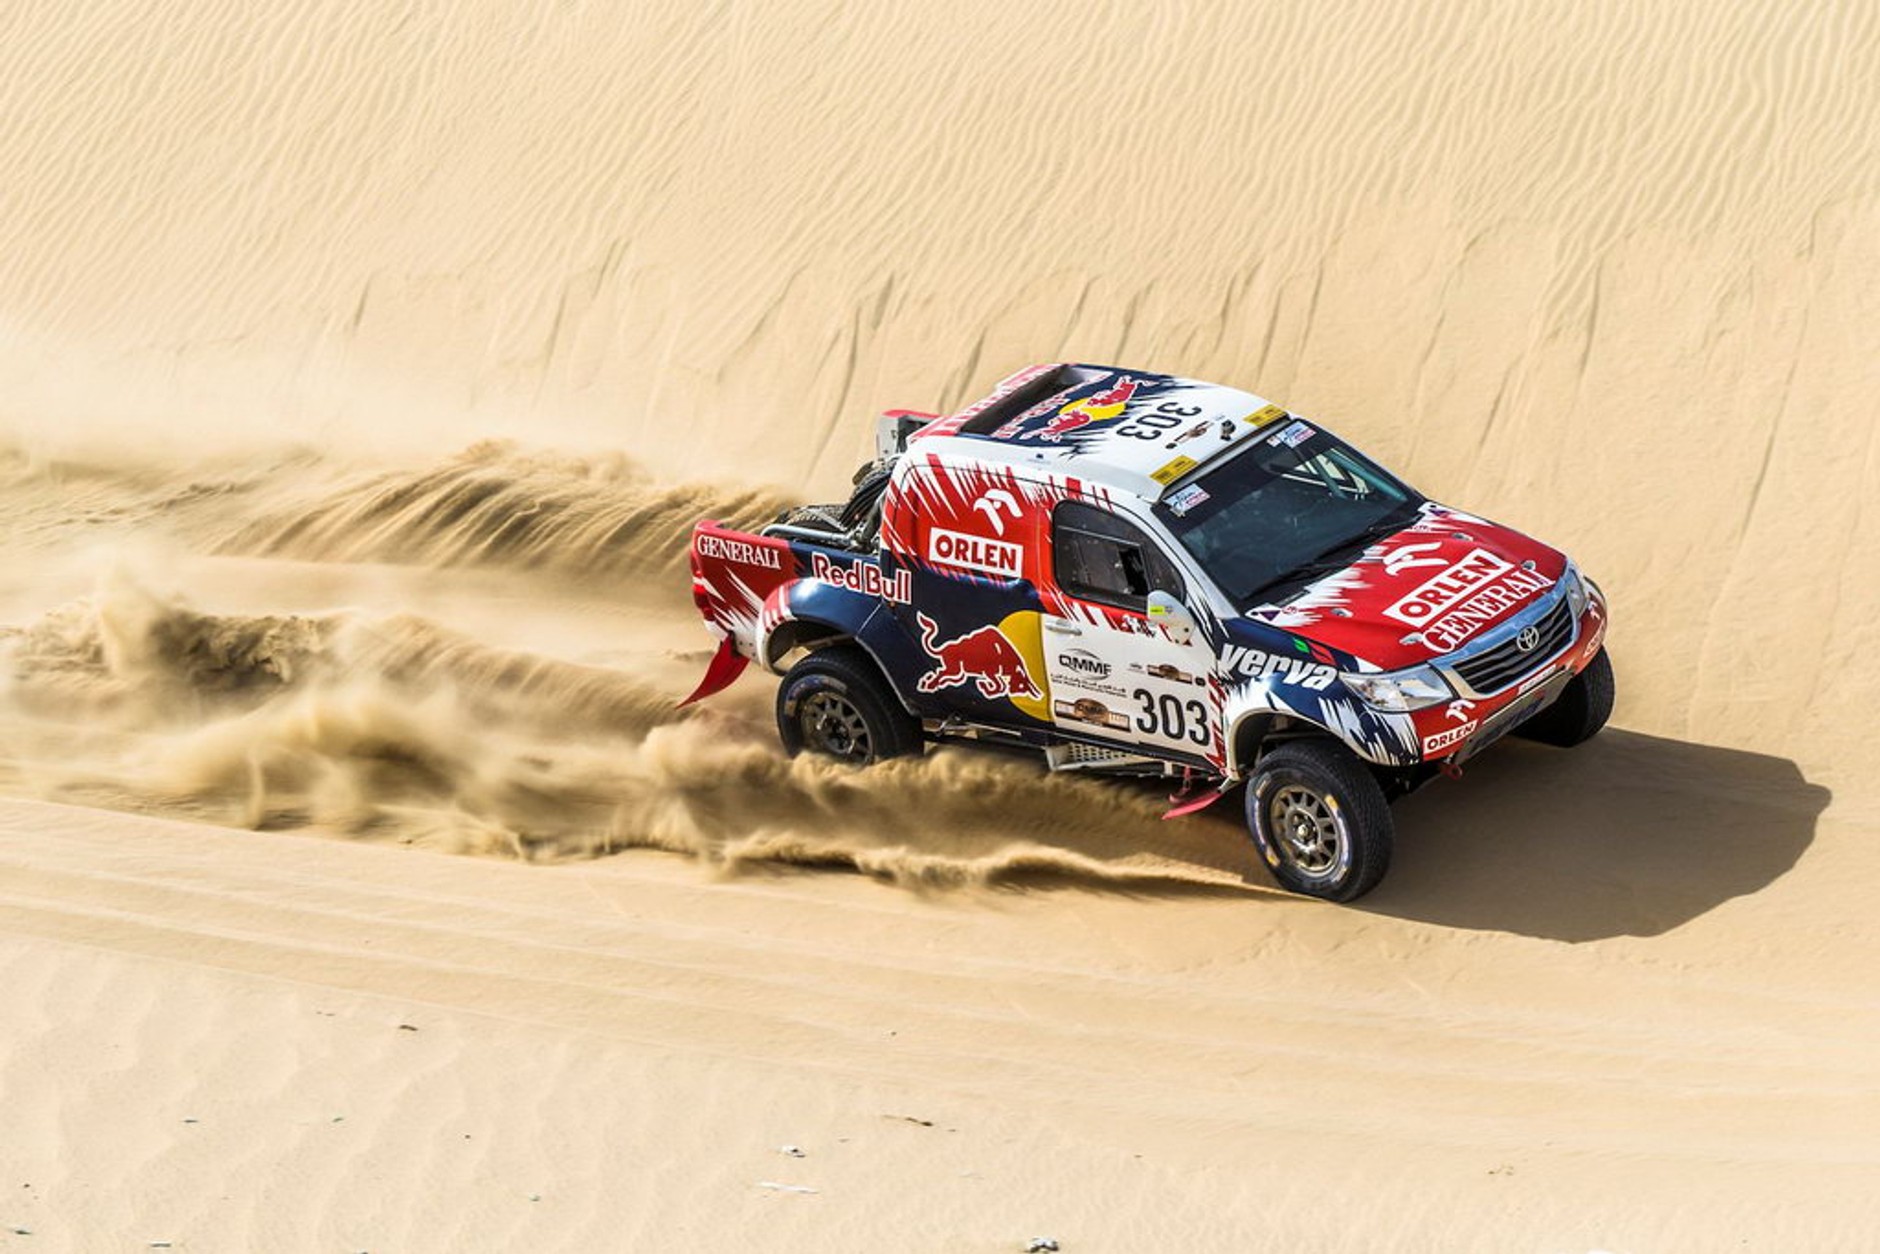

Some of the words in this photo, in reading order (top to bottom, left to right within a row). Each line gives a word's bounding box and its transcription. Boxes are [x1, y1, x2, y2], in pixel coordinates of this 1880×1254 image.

[1116, 402, 1202, 440] 303
[695, 533, 782, 570] GENERALI
[935, 534, 1016, 571] ORLEN
[1399, 554, 1502, 617] ORLEN
[1422, 569, 1557, 653] GENERALI
[1058, 653, 1112, 676] QMMF
[1220, 642, 1338, 691] verva
[1132, 688, 1211, 747] 303
[1426, 723, 1475, 751] ORLEN
